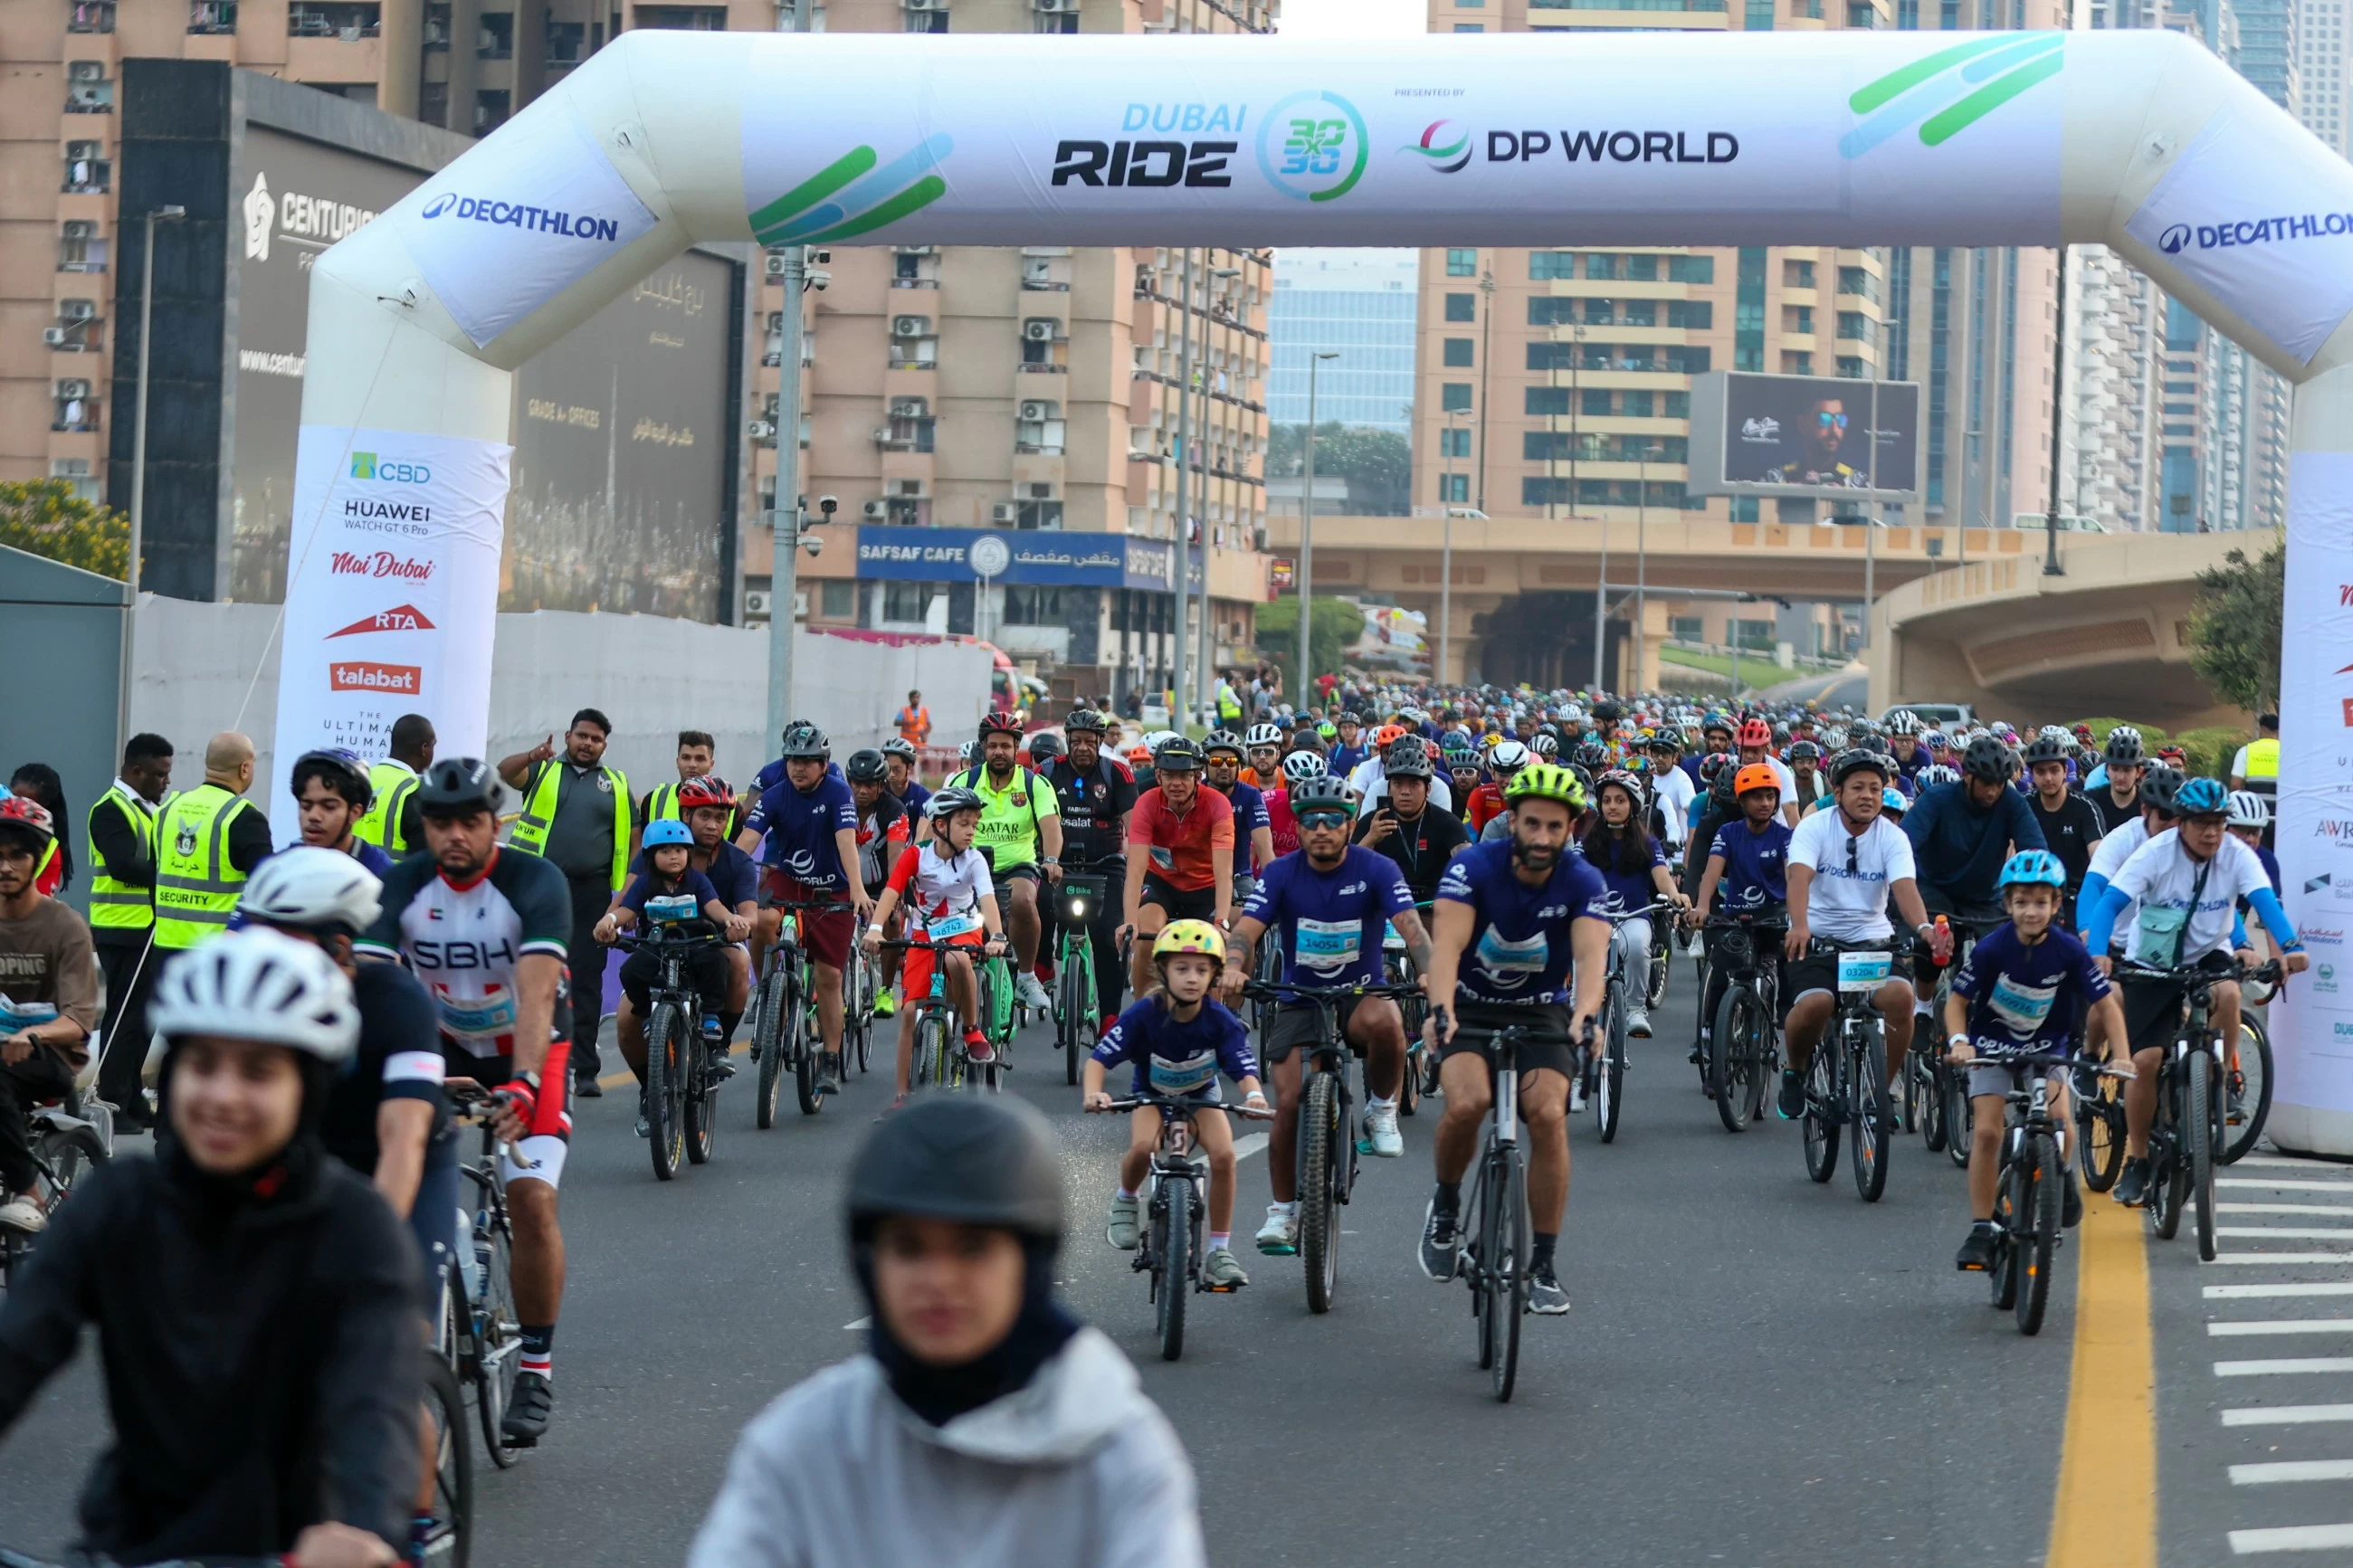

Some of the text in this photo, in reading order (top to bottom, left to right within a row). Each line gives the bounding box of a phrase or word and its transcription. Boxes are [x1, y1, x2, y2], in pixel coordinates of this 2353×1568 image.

[1395, 88, 1465, 97] PRESENTED BY
[1122, 103, 1247, 133] DUBAI
[1487, 129, 1739, 163] DP WORLD
[1051, 140, 1238, 187] RIDE
[281, 191, 384, 241] CENTURI
[457, 197, 618, 242] DECATHLON
[379, 462, 431, 484] CBD
[345, 500, 430, 522] HUAWEI
[345, 519, 429, 535] WATCH GT 6 Pro
[860, 545, 965, 562] SAFSAF CAFE
[331, 551, 434, 581] Mai Dubai
[375, 613, 418, 630] RTA
[337, 667, 413, 689] talabat
[359, 711, 381, 719] THE
[323, 720, 393, 734] ULTIMA
[336, 735, 387, 747] HUMA
[976, 822, 1019, 834] QATAR
[985, 832, 1019, 841] AIRWAYS
[159, 891, 210, 905] SECURITY
[1075, 887, 1091, 895] Bike
[1305, 938, 1339, 949] 14054
[414, 937, 515, 970] SBH
[1845, 967, 1874, 976] 03204
